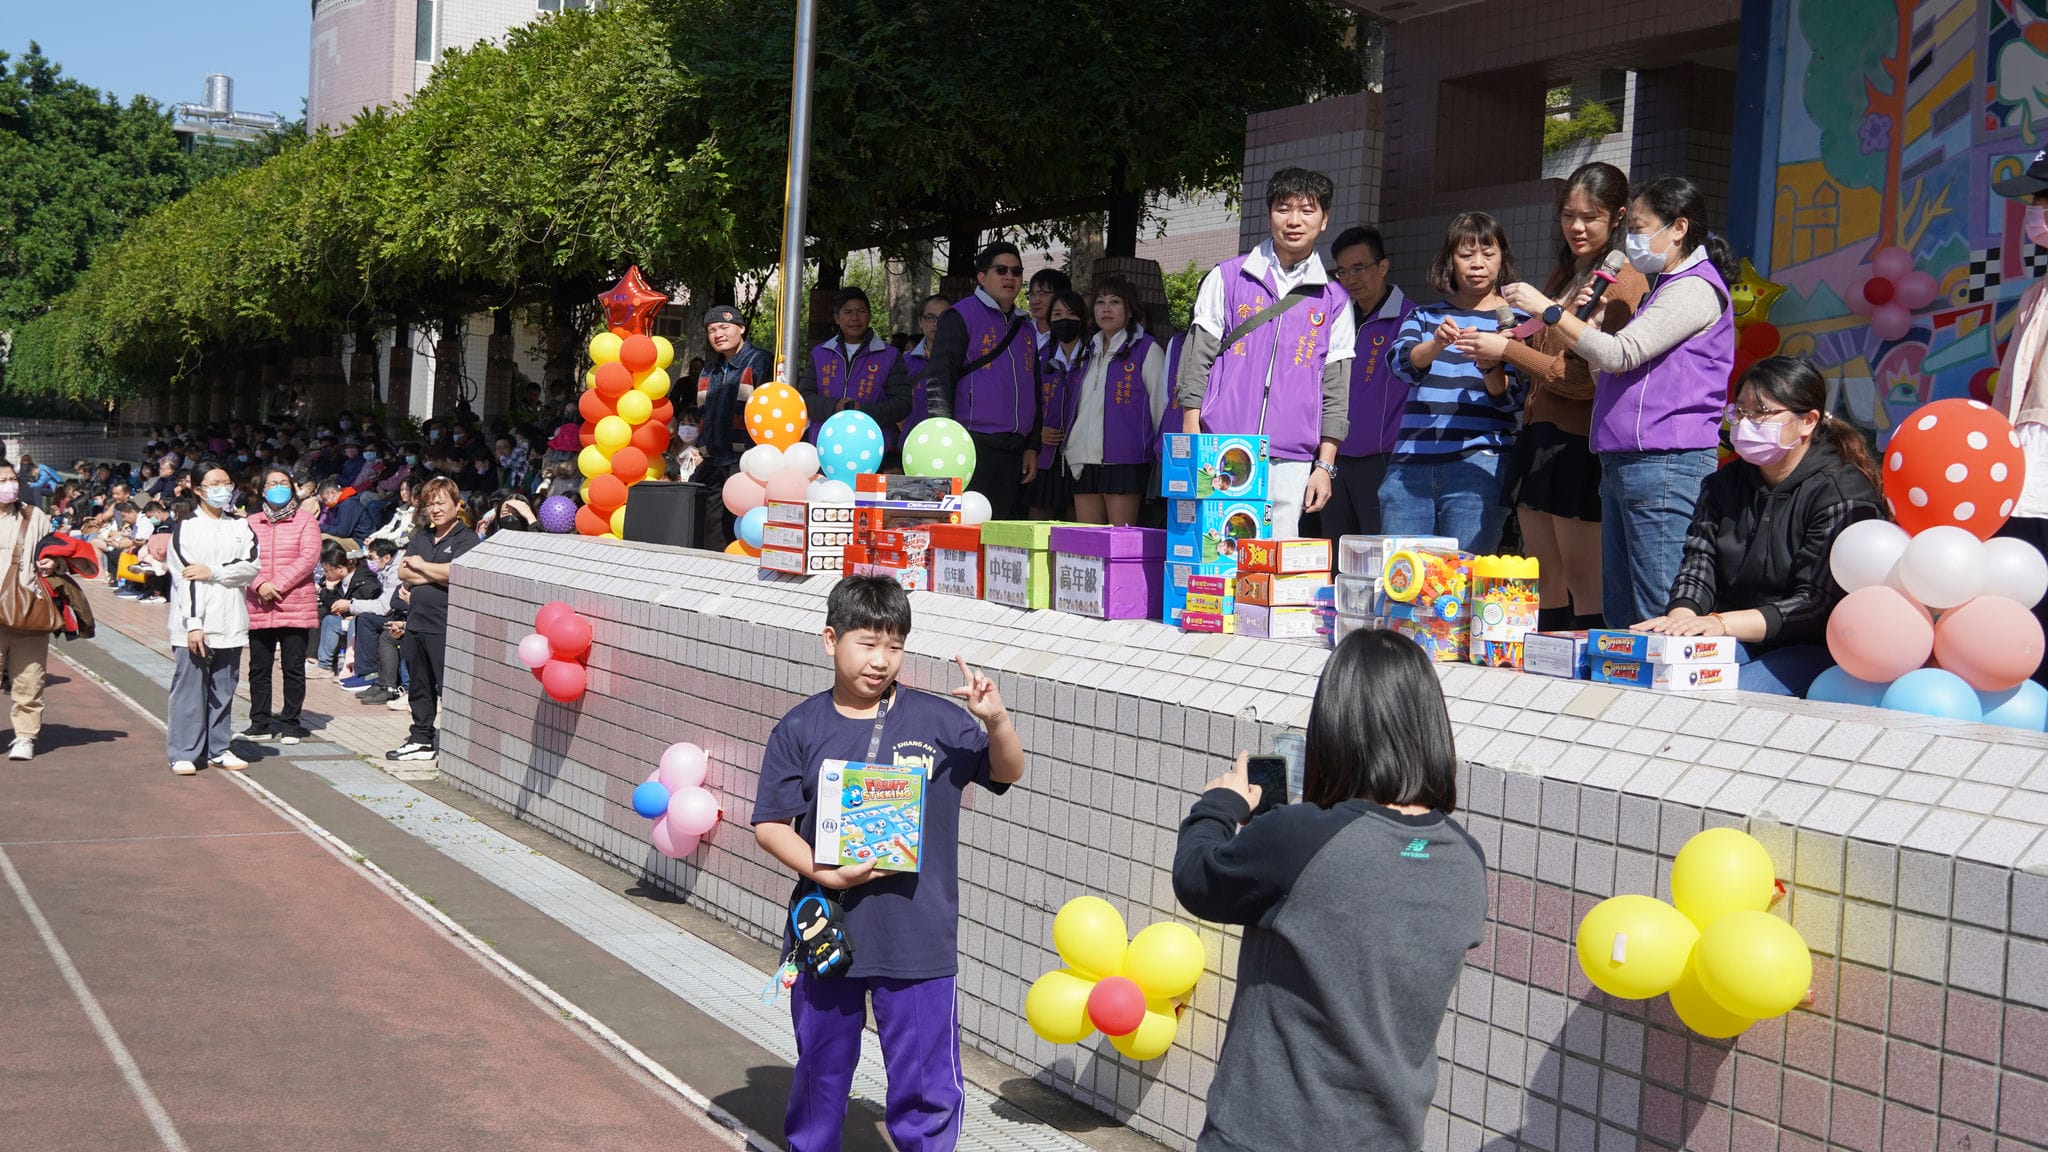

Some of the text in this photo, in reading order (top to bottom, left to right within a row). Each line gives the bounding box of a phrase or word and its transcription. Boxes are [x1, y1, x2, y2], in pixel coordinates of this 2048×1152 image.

[1233, 303, 1252, 356] 徐凱
[942, 497, 956, 510] 7
[990, 558, 1023, 585] 中年級
[1060, 565, 1097, 593] 高年級
[923, 743, 934, 753] AN
[864, 778, 908, 791] FRUIT
[862, 790, 912, 801] STICKING
